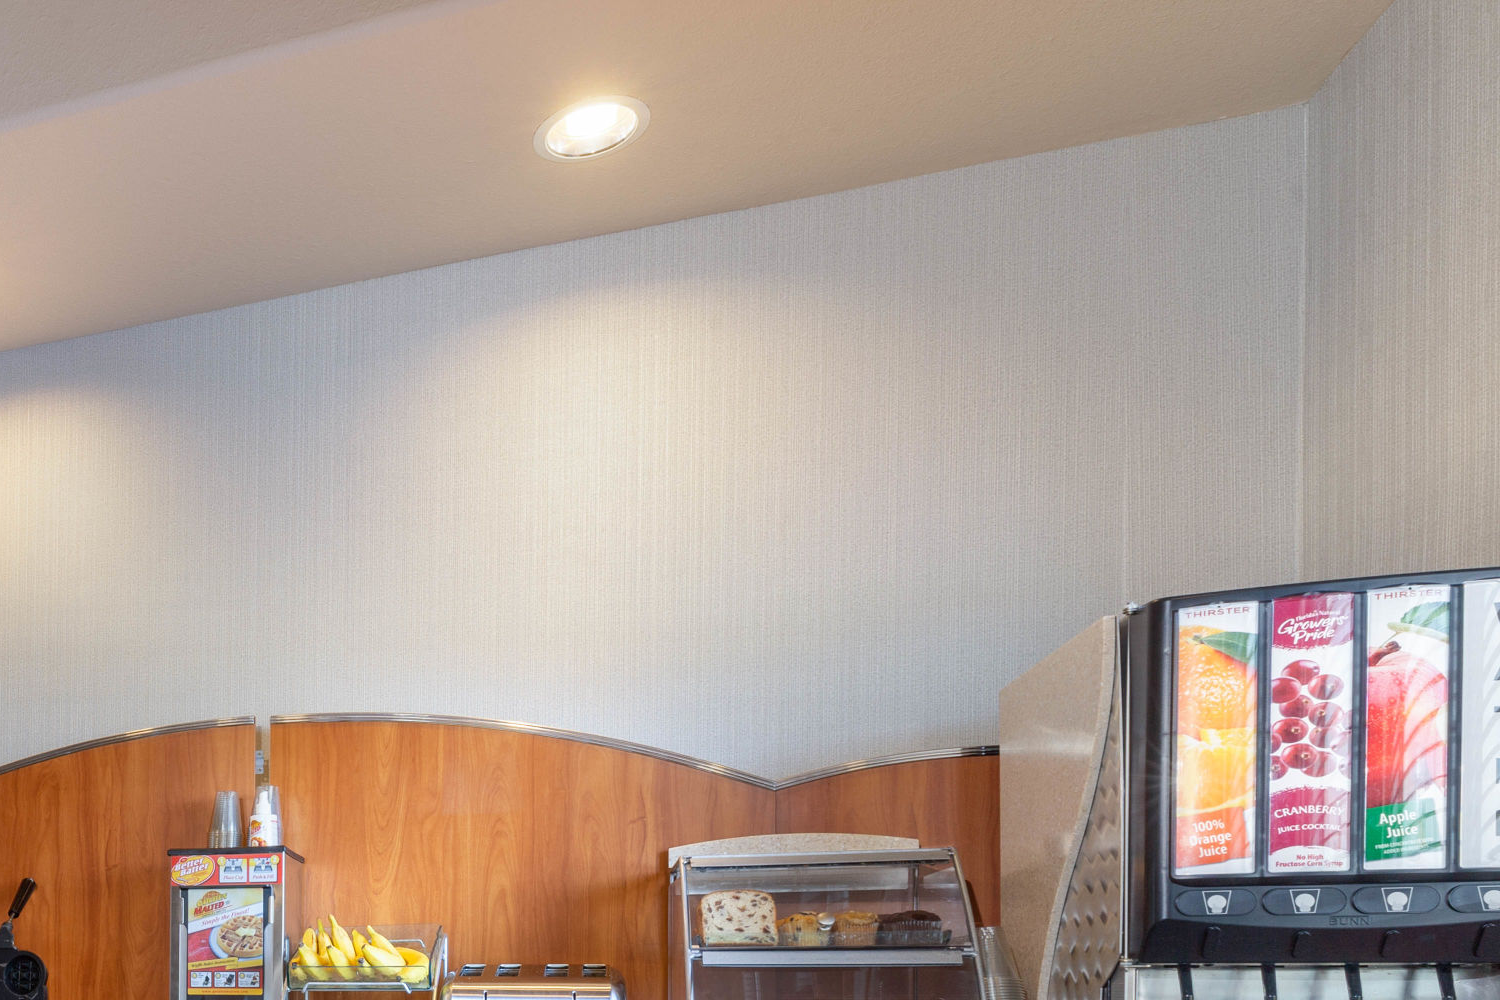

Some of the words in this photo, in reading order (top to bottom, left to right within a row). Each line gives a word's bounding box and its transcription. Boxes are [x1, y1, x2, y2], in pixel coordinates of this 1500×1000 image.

[1375, 589, 1442, 600] THIRSTER
[1185, 606, 1250, 619] THIRSTER
[1291, 627, 1335, 645] Pride
[1273, 804, 1344, 819] CRANBERRY
[1379, 810, 1417, 826] Apple
[1192, 818, 1225, 833] 100%
[1277, 824, 1301, 835] JUICE
[1301, 823, 1342, 832] COCKTAIL
[1386, 825, 1419, 839] Juice
[1188, 831, 1233, 847] Orange
[1198, 844, 1228, 858] Juice
[1307, 853, 1324, 861] High
[174, 857, 205, 872] Better
[180, 863, 209, 877] Batter
[1275, 860, 1306, 868] Fructose
[193, 900, 225, 915] MALTED
[1329, 915, 1371, 926] BUNN
